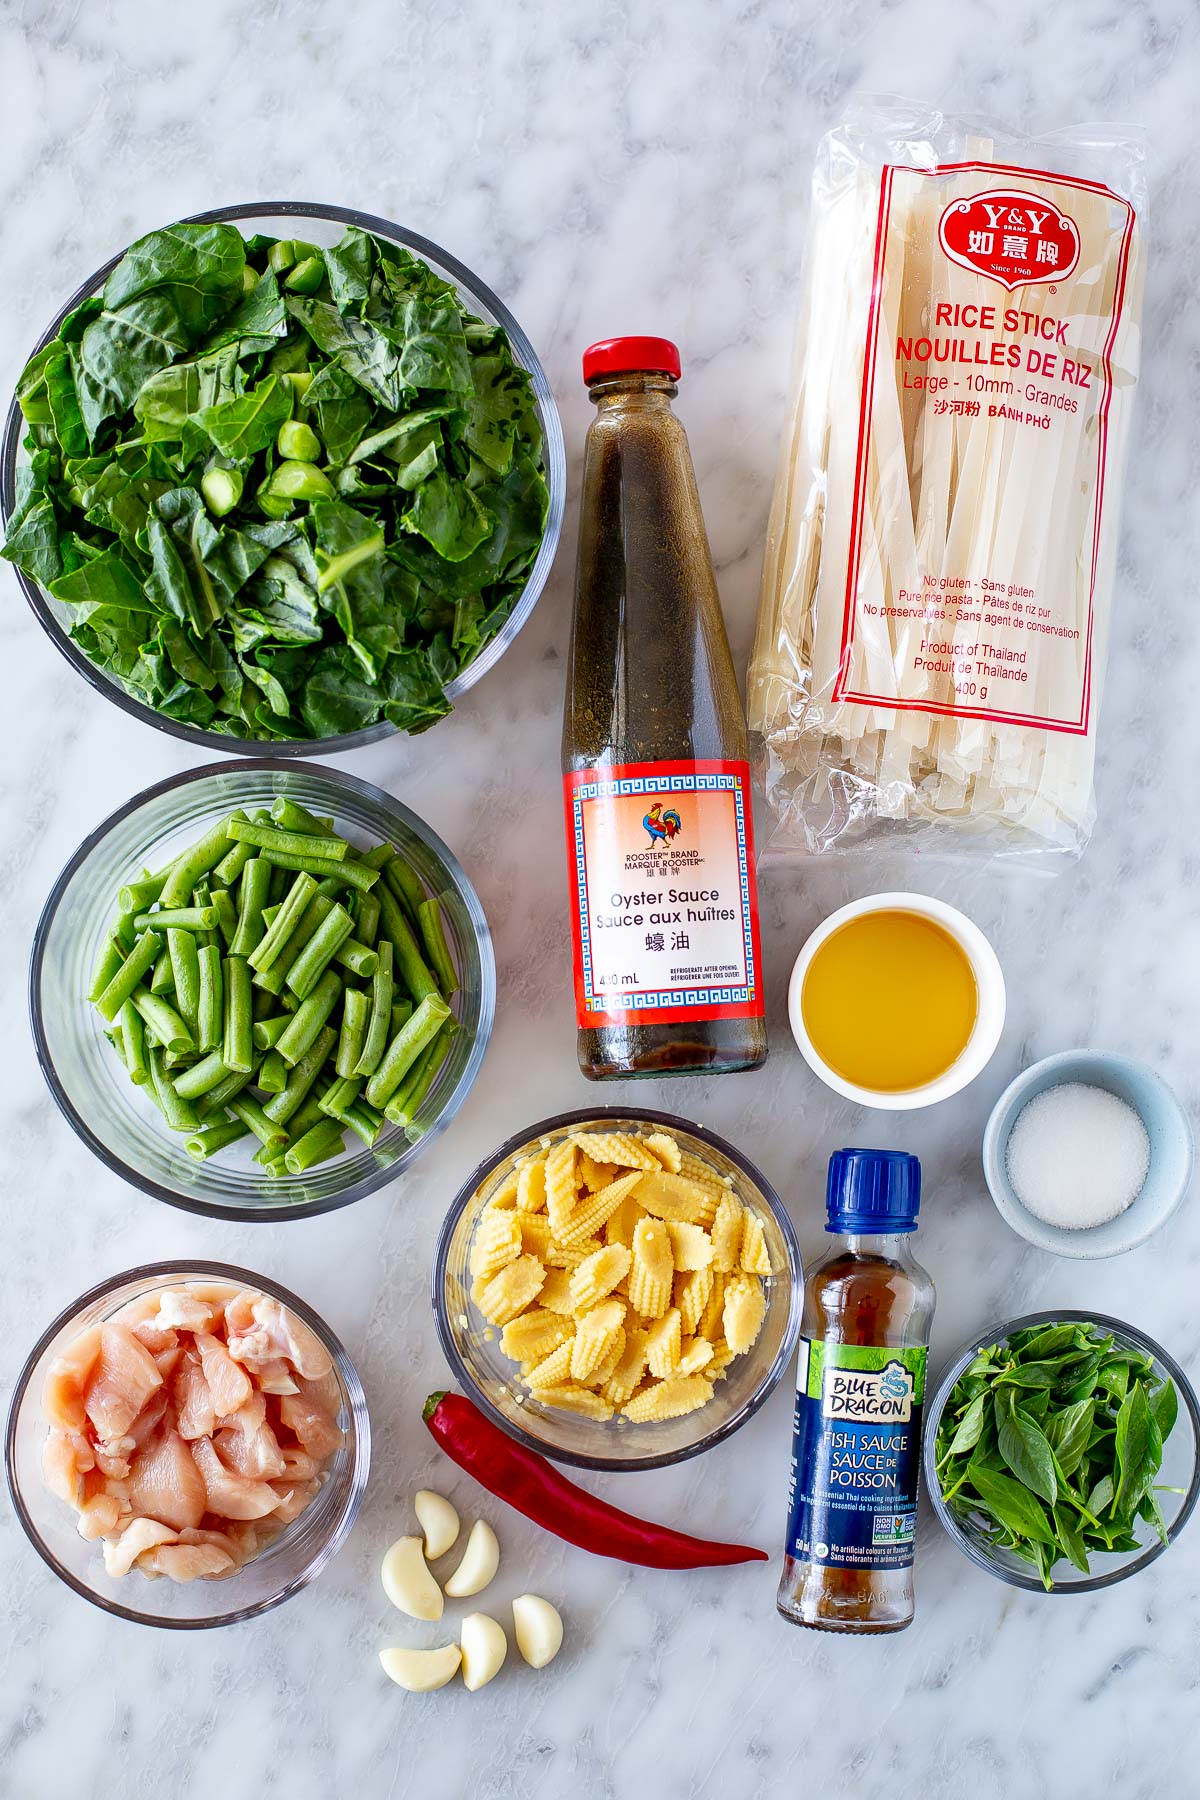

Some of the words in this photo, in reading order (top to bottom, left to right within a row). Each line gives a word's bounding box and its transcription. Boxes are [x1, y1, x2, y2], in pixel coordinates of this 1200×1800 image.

[982, 204, 1050, 235] Y&Y
[1003, 224, 1026, 232] BRAND
[967, 230, 1059, 265] 如意牌
[990, 263, 1011, 273] Since
[1013, 266, 1032, 276] 1960
[935, 303, 996, 330] RICE
[1003, 308, 1070, 346] STICK
[896, 336, 1022, 368] NOUILLES
[1026, 348, 1057, 378] DE
[1061, 358, 1092, 389] RIZ
[903, 371, 949, 394] Large
[966, 374, 1014, 395] 10mm
[1025, 383, 1078, 414] Grandes
[933, 399, 981, 417] 沙河粉
[988, 403, 1023, 423] BÁNH
[1025, 412, 1051, 430] PHỞ
[923, 575, 937, 587] No
[939, 576, 971, 590] gluten
[981, 578, 1006, 593] Sans
[1007, 584, 1035, 599] gluten
[898, 589, 922, 602] Pure
[924, 592, 942, 603] rice
[944, 594, 973, 606] pasta
[983, 594, 1010, 610] Pâtes
[1012, 600, 1023, 613] de
[1025, 603, 1036, 616] riz
[1038, 607, 1051, 620] pur
[863, 603, 878, 616] No
[880, 607, 946, 620] preservatives
[955, 609, 981, 622] Sans
[984, 613, 1011, 628] agent
[1013, 616, 1024, 628] de
[1026, 620, 1080, 640] conservation
[920, 639, 964, 655] Product
[966, 643, 979, 656] of
[982, 644, 1027, 664] Thailand
[913, 657, 956, 674] Produit
[958, 660, 972, 674] de
[976, 661, 1028, 682] Thaïlande
[955, 681, 976, 696] 400
[980, 685, 988, 700] g
[670, 850, 699, 859] BRAND
[624, 860, 660, 870] MARQUE
[611, 891, 663, 909] Oyster
[669, 889, 719, 903] Sauce
[597, 914, 643, 928] Sauce
[650, 911, 682, 924] aux
[687, 907, 735, 922] huîtres
[645, 930, 690, 952] 蠔油
[621, 972, 640, 985] mL
[670, 966, 703, 975] REFRIGERATE
[704, 965, 718, 973] AFTER
[833, 1377, 879, 1397] BLUE
[823, 1431, 855, 1450] FISH
[860, 1434, 908, 1452] SAUCE
[832, 1451, 884, 1470] SAUCE
[886, 1458, 897, 1468] DE
[829, 1471, 897, 1488] POISSON
[846, 1492, 859, 1501] Thai
[860, 1494, 884, 1503] cooking
[859, 1503, 866, 1511] de
[867, 1503, 873, 1511] la
[830, 1552, 845, 1561] Sans
[845, 1554, 873, 1563] colorants
[831, 1544, 840, 1552] No
[840, 1545, 865, 1554] artificial
[865, 1547, 886, 1555] colours
